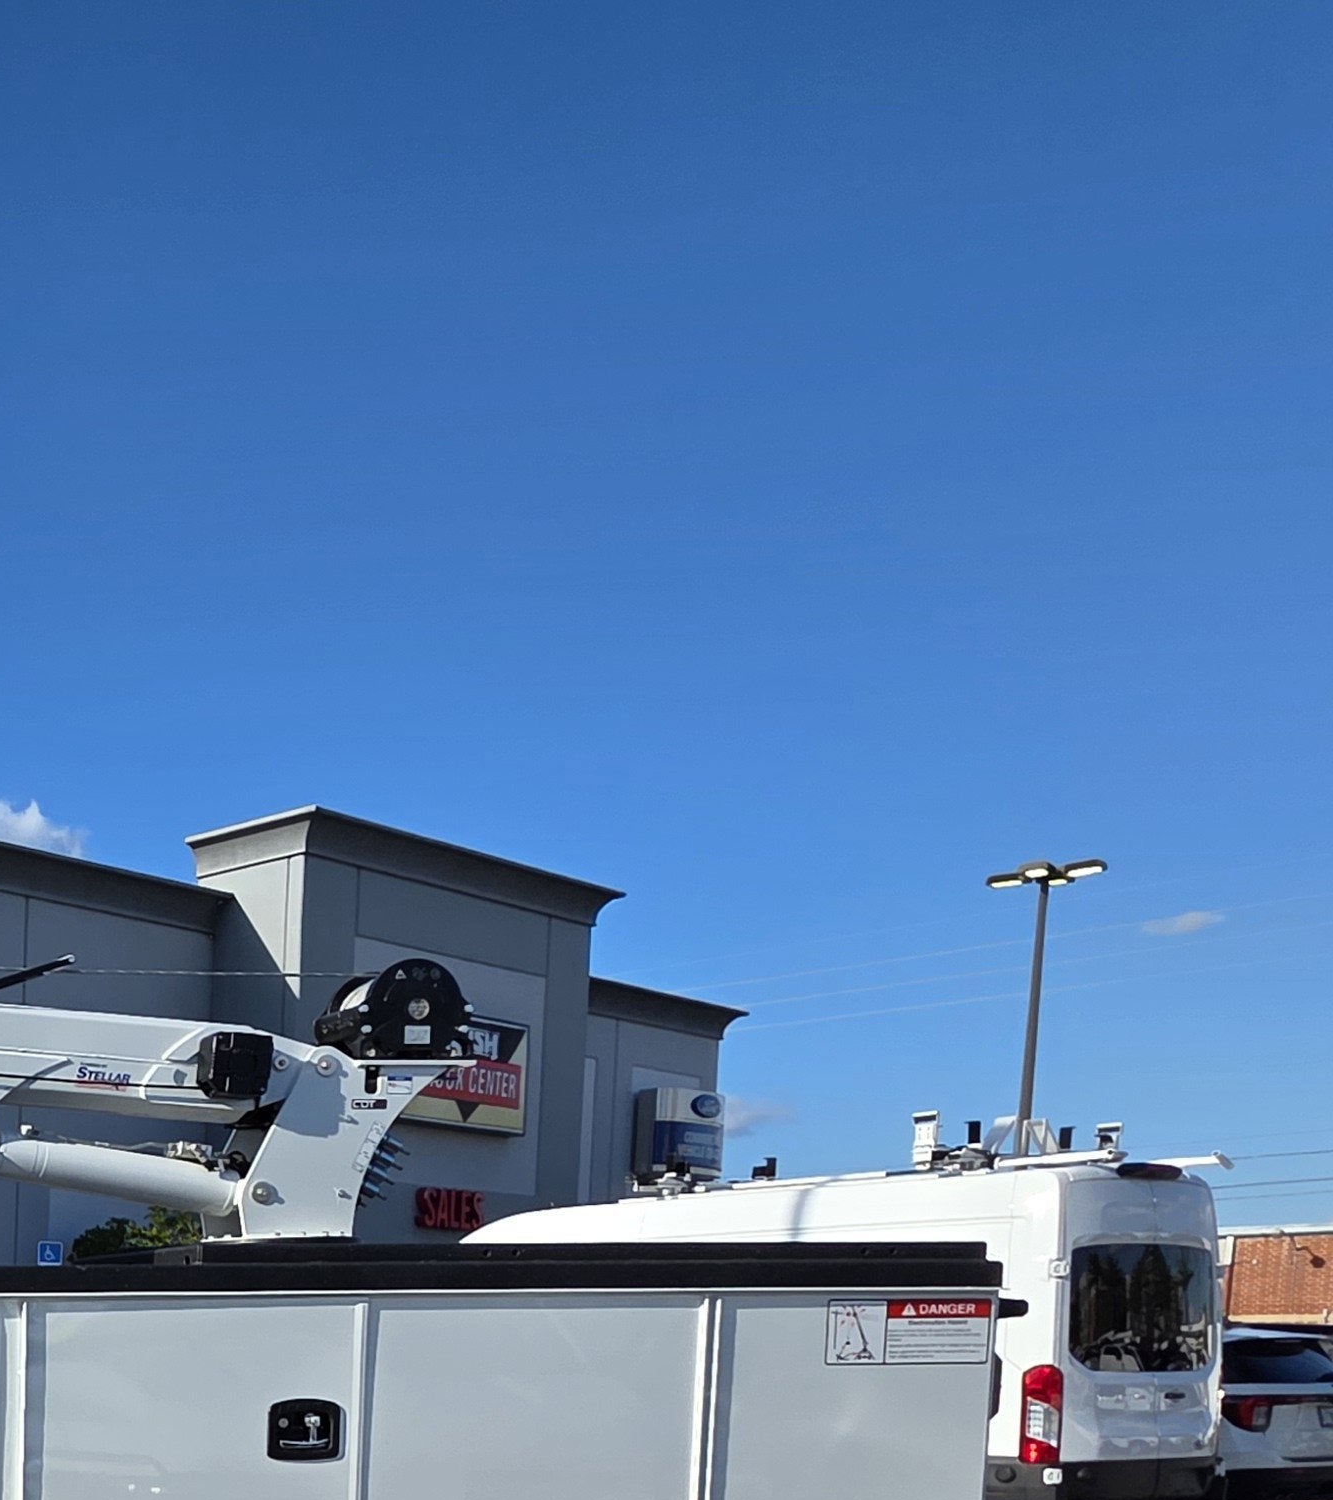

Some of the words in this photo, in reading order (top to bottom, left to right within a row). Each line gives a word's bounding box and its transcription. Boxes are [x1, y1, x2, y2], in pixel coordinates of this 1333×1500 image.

[76, 1066, 131, 1085] STELLAR
[468, 1067, 517, 1099] CENTER
[419, 1188, 485, 1230] SALES
[918, 1303, 976, 1316] DANGER
